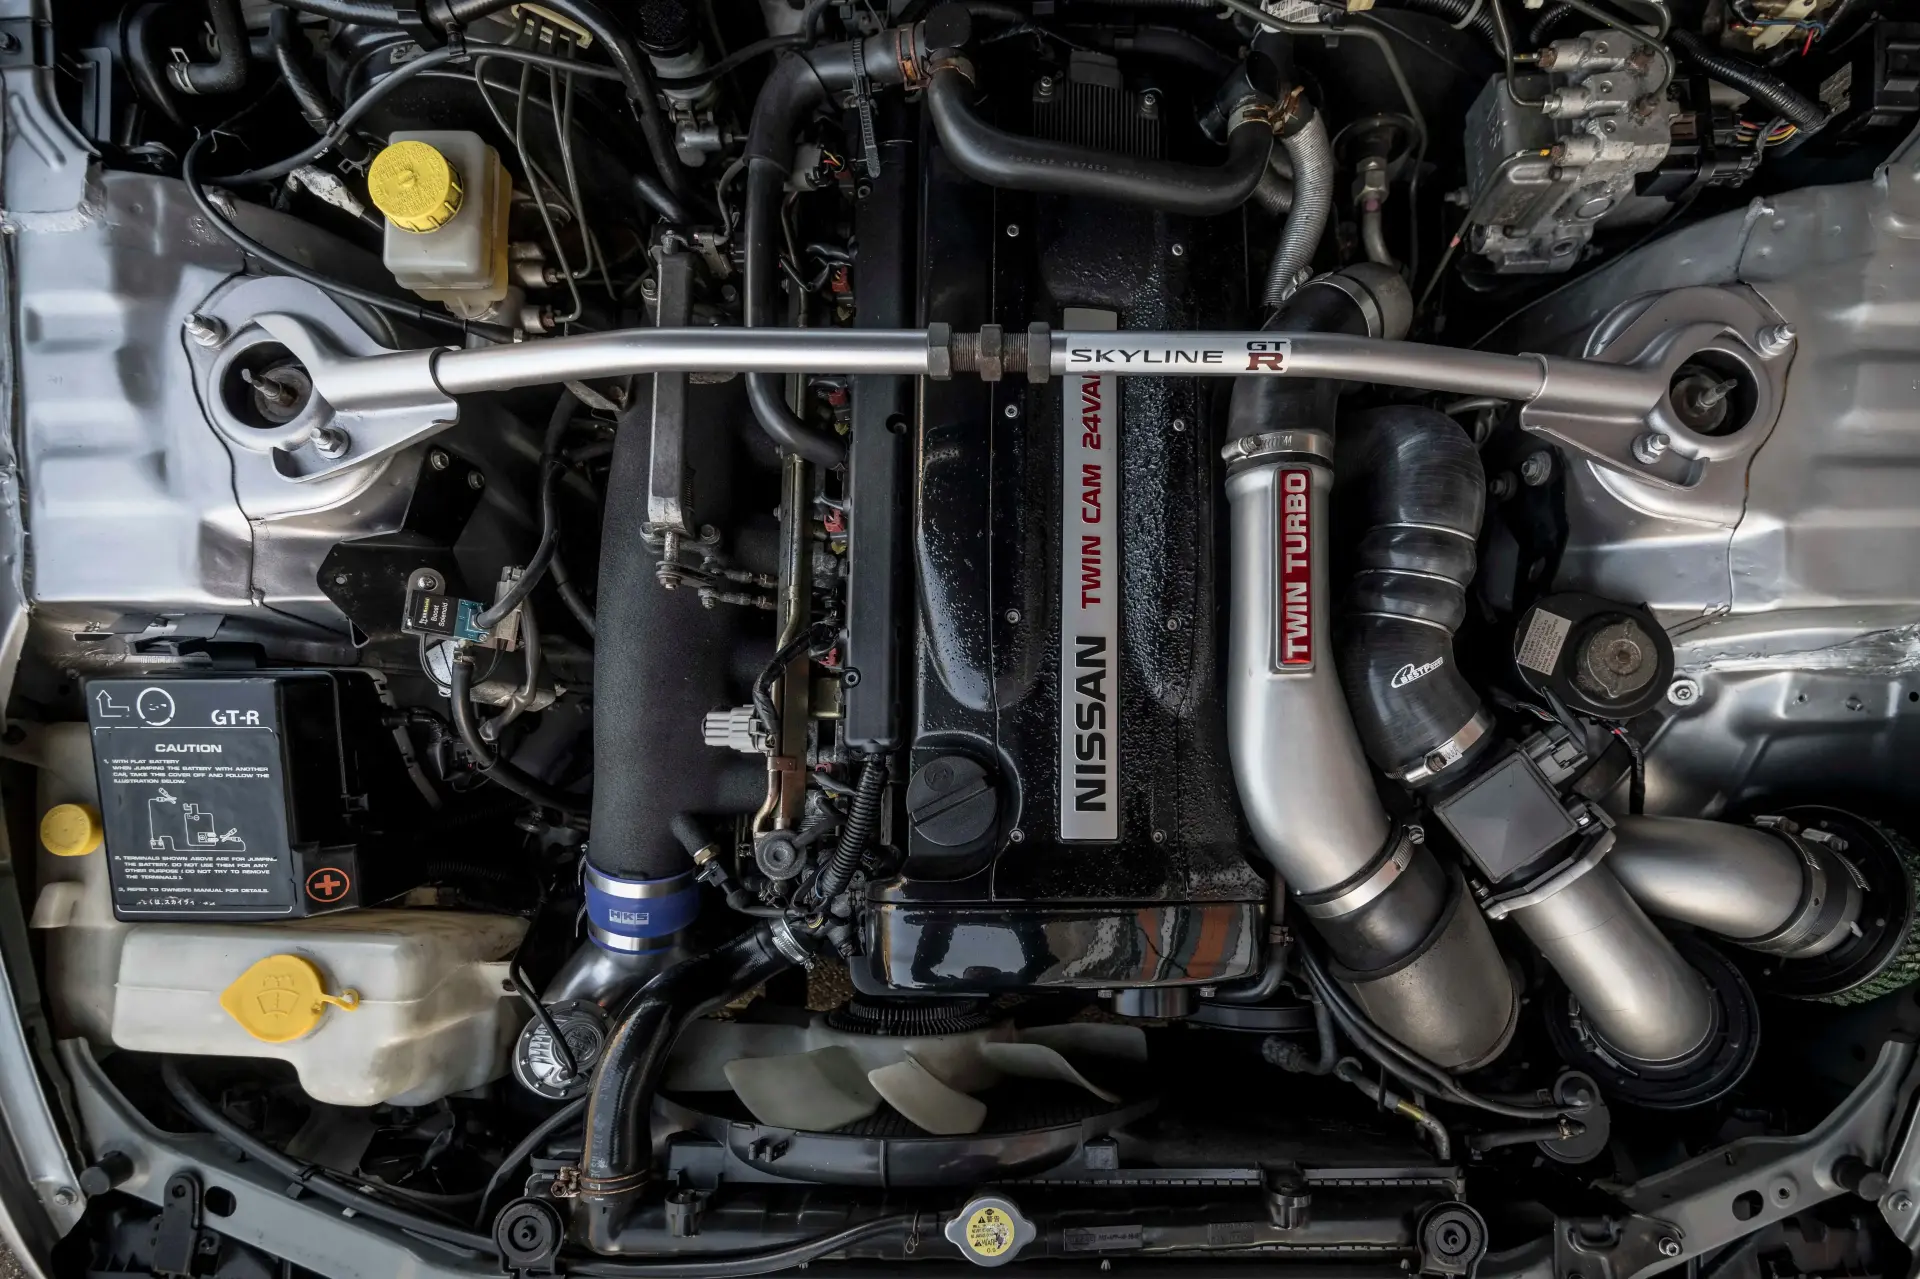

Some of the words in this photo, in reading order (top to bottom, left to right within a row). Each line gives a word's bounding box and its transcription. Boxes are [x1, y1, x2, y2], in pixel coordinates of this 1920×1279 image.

[1246, 341, 1287, 351] GT
[1070, 349, 1224, 363] SKYLINE
[1245, 352, 1284, 371] R
[1082, 464, 1102, 524] CAM
[1285, 473, 1307, 574] TURBO
[1081, 536, 1101, 610] TWIN
[430, 604, 440, 622] Boost
[1285, 582, 1308, 660] TWIN
[211, 709, 260, 725] GT-R
[1074, 636, 1107, 812] NISSAN
[155, 744, 222, 753] CAUTION
[609, 909, 649, 923] HKS
